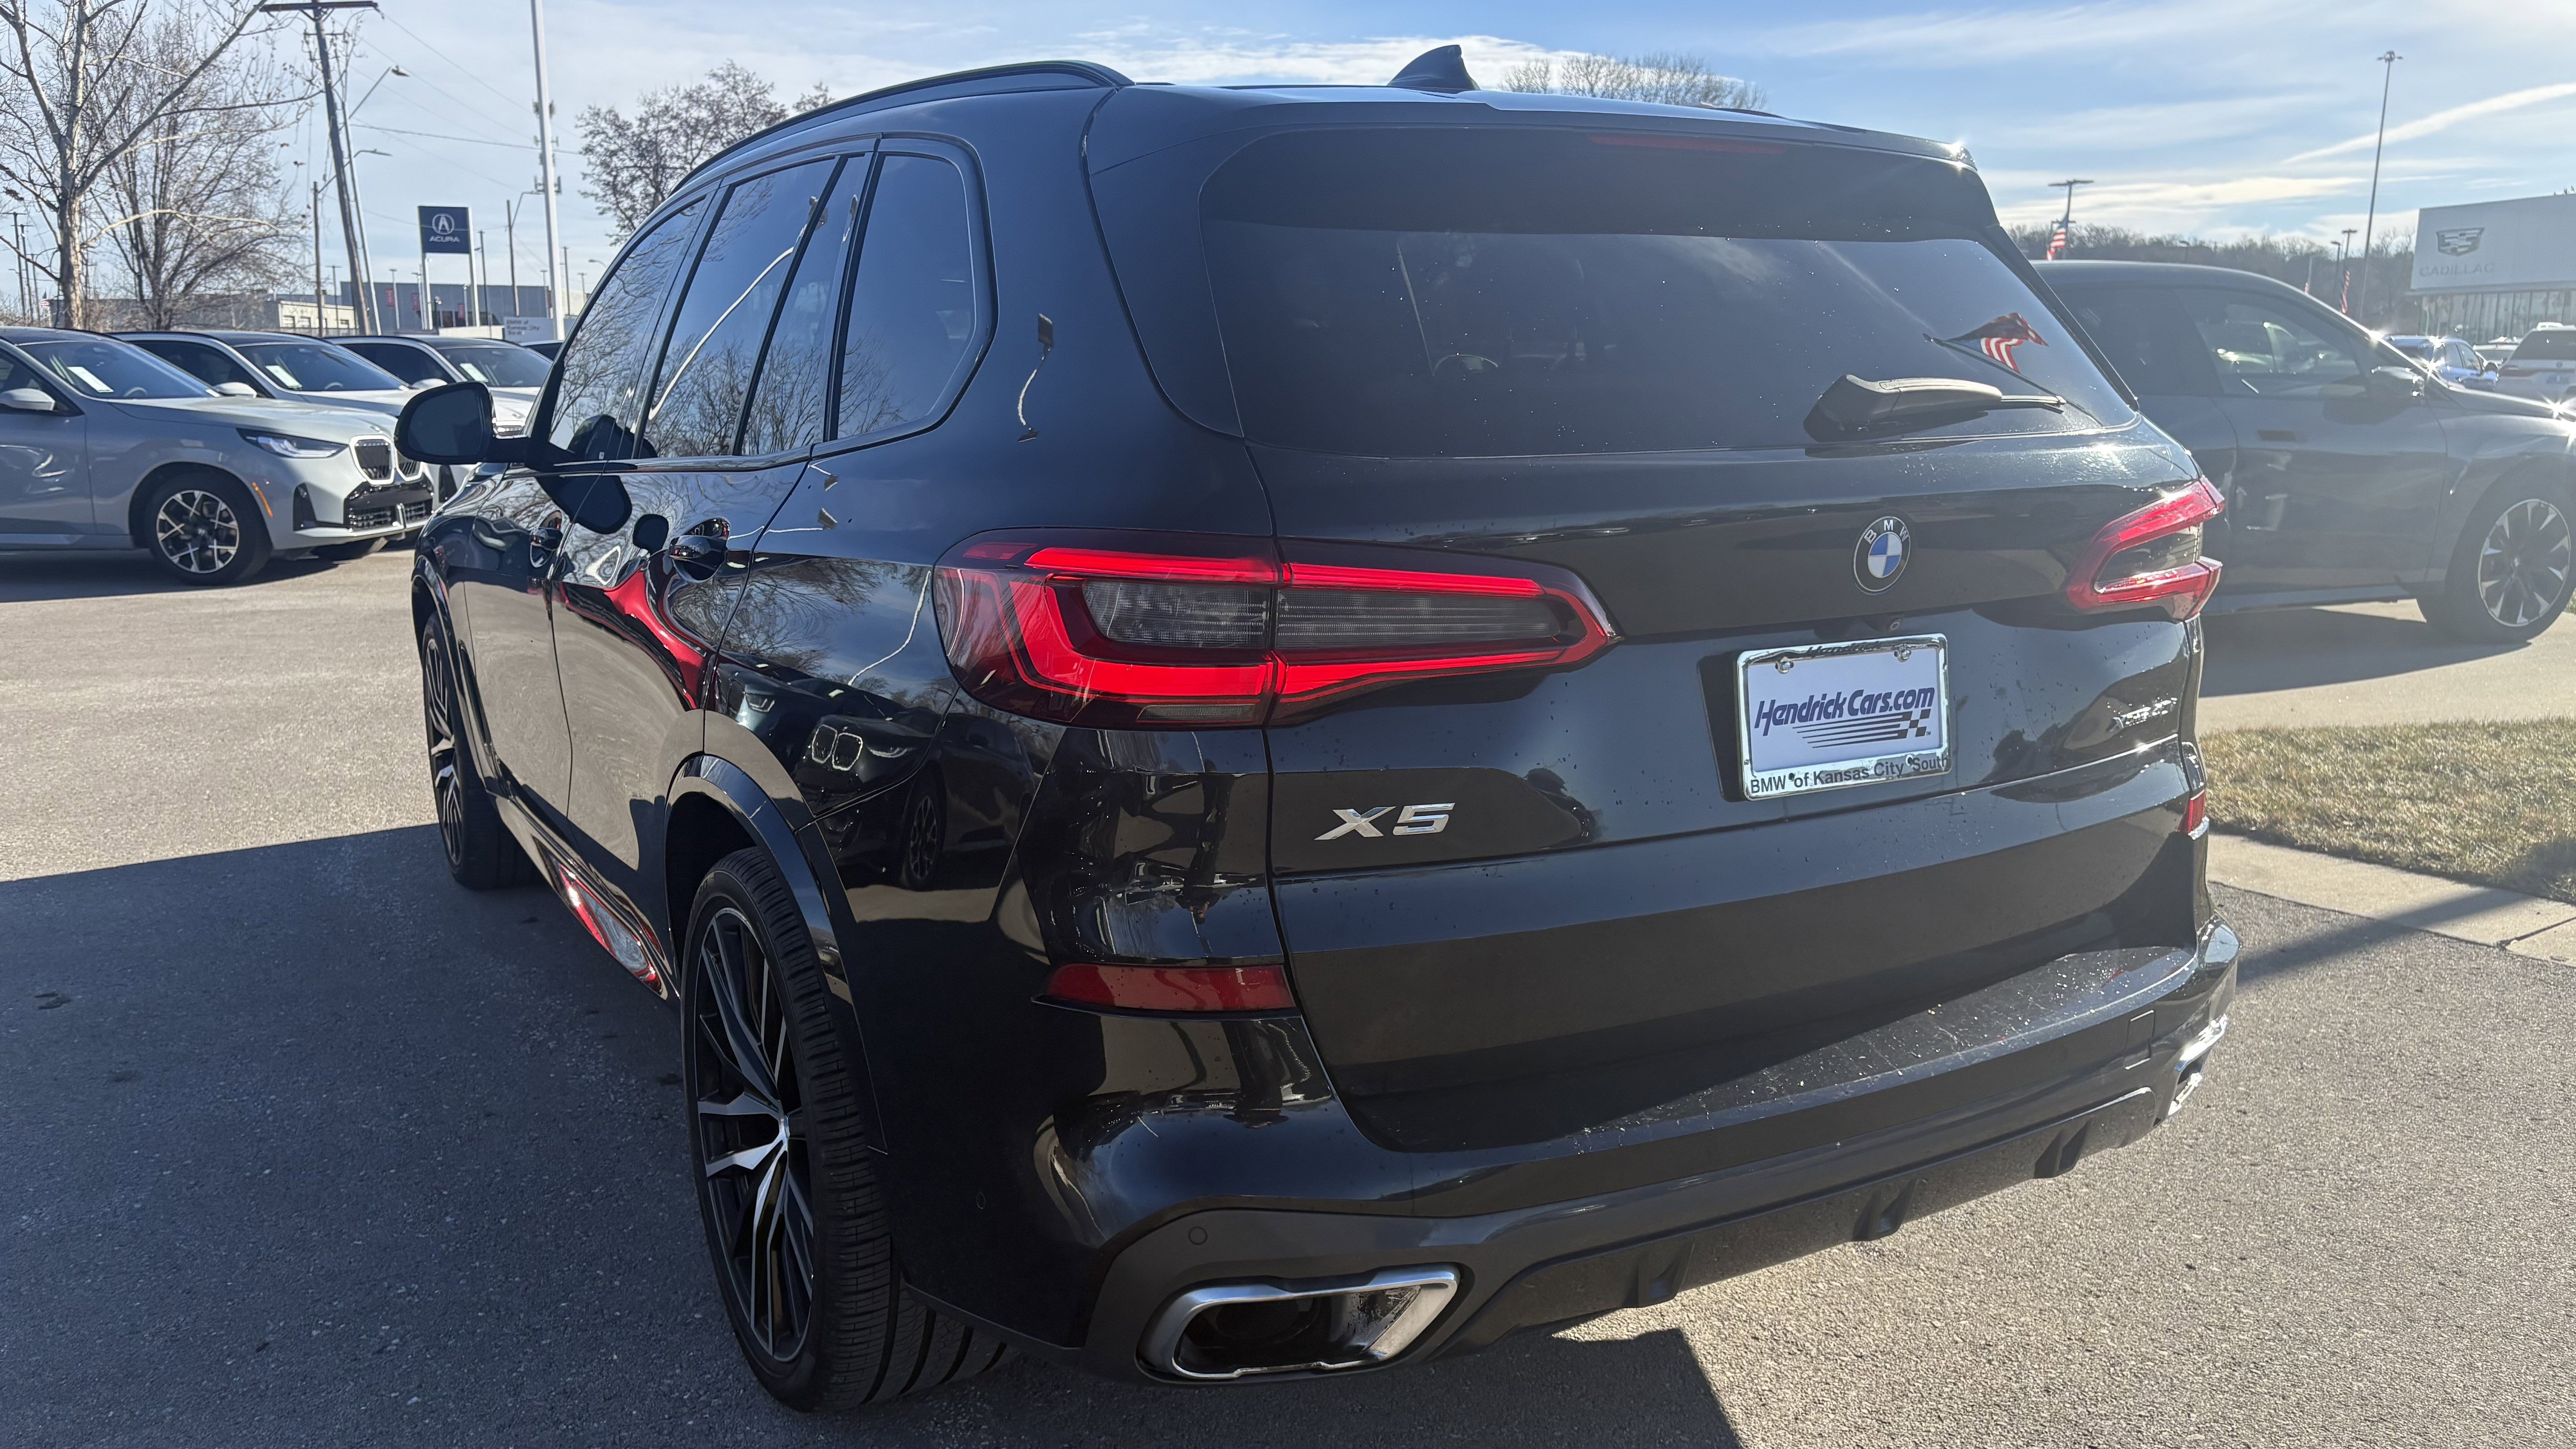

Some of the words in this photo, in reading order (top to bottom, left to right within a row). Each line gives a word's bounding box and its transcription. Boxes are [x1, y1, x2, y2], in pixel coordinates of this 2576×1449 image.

[2420, 263, 2494, 276] CADILLAC
[1864, 519, 1909, 544] BMW
[1750, 775, 1786, 794] BMW
[1794, 772, 1809, 788] of
[1813, 766, 1869, 785] Kansas
[1873, 761, 1904, 777] City
[1912, 754, 1948, 772] South
[1314, 802, 1456, 841] X5
